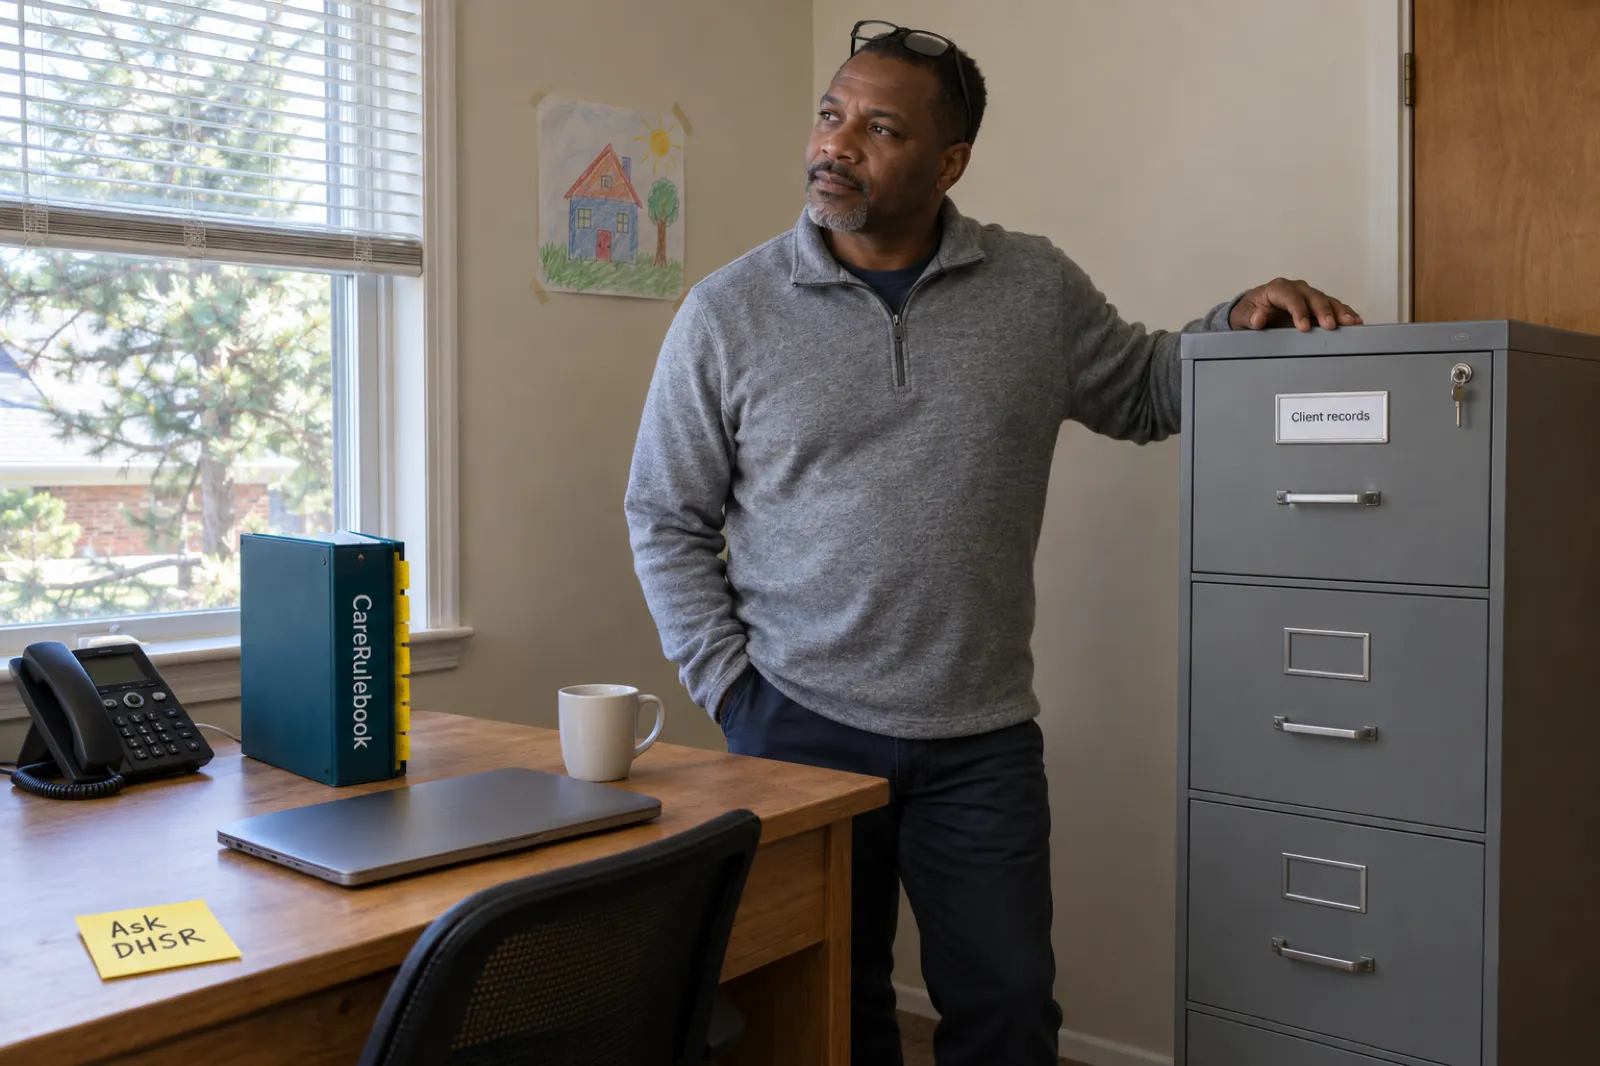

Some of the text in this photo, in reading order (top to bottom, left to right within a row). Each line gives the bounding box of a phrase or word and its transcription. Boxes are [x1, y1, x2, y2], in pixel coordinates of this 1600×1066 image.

[1291, 410, 1370, 423] Client records
[353, 594, 372, 750] CareRulebook
[112, 928, 207, 959] DHSR
